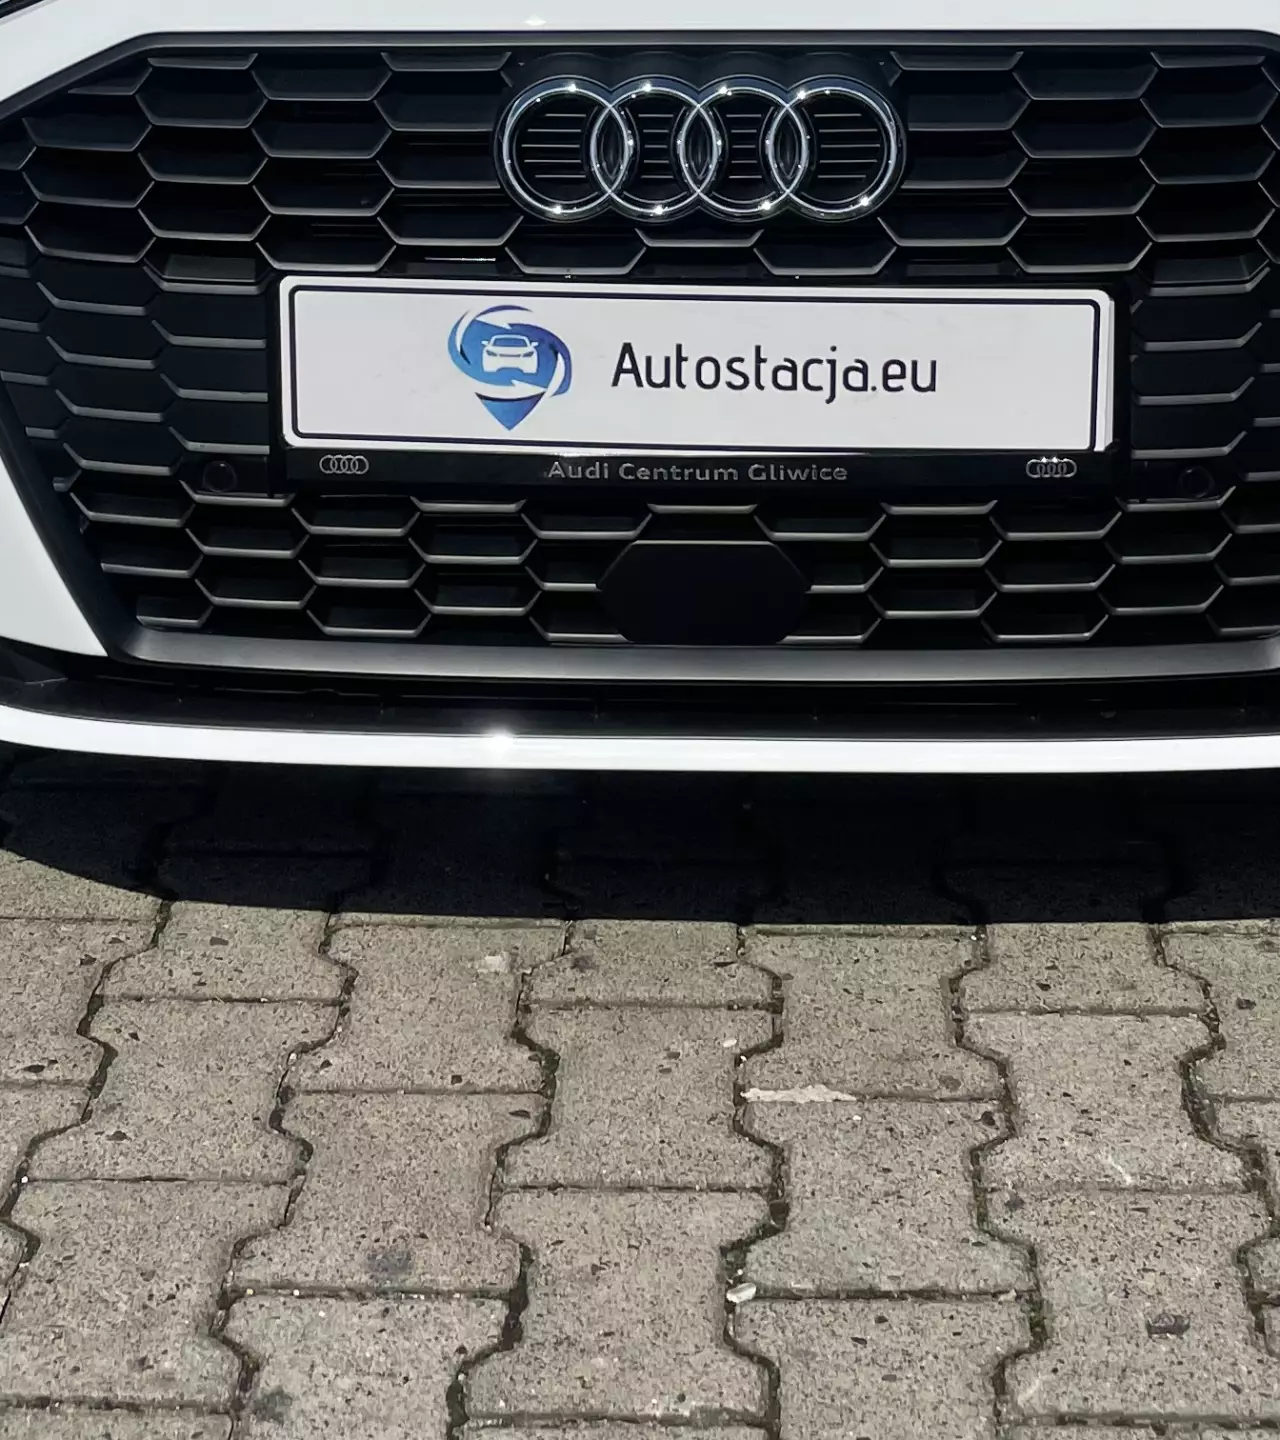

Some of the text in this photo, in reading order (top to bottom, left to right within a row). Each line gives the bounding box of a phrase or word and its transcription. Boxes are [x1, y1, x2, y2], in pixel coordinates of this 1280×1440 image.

[611, 342, 937, 404] Autostacja.eu
[548, 462, 847, 481] Audi Centrum Gliwice
